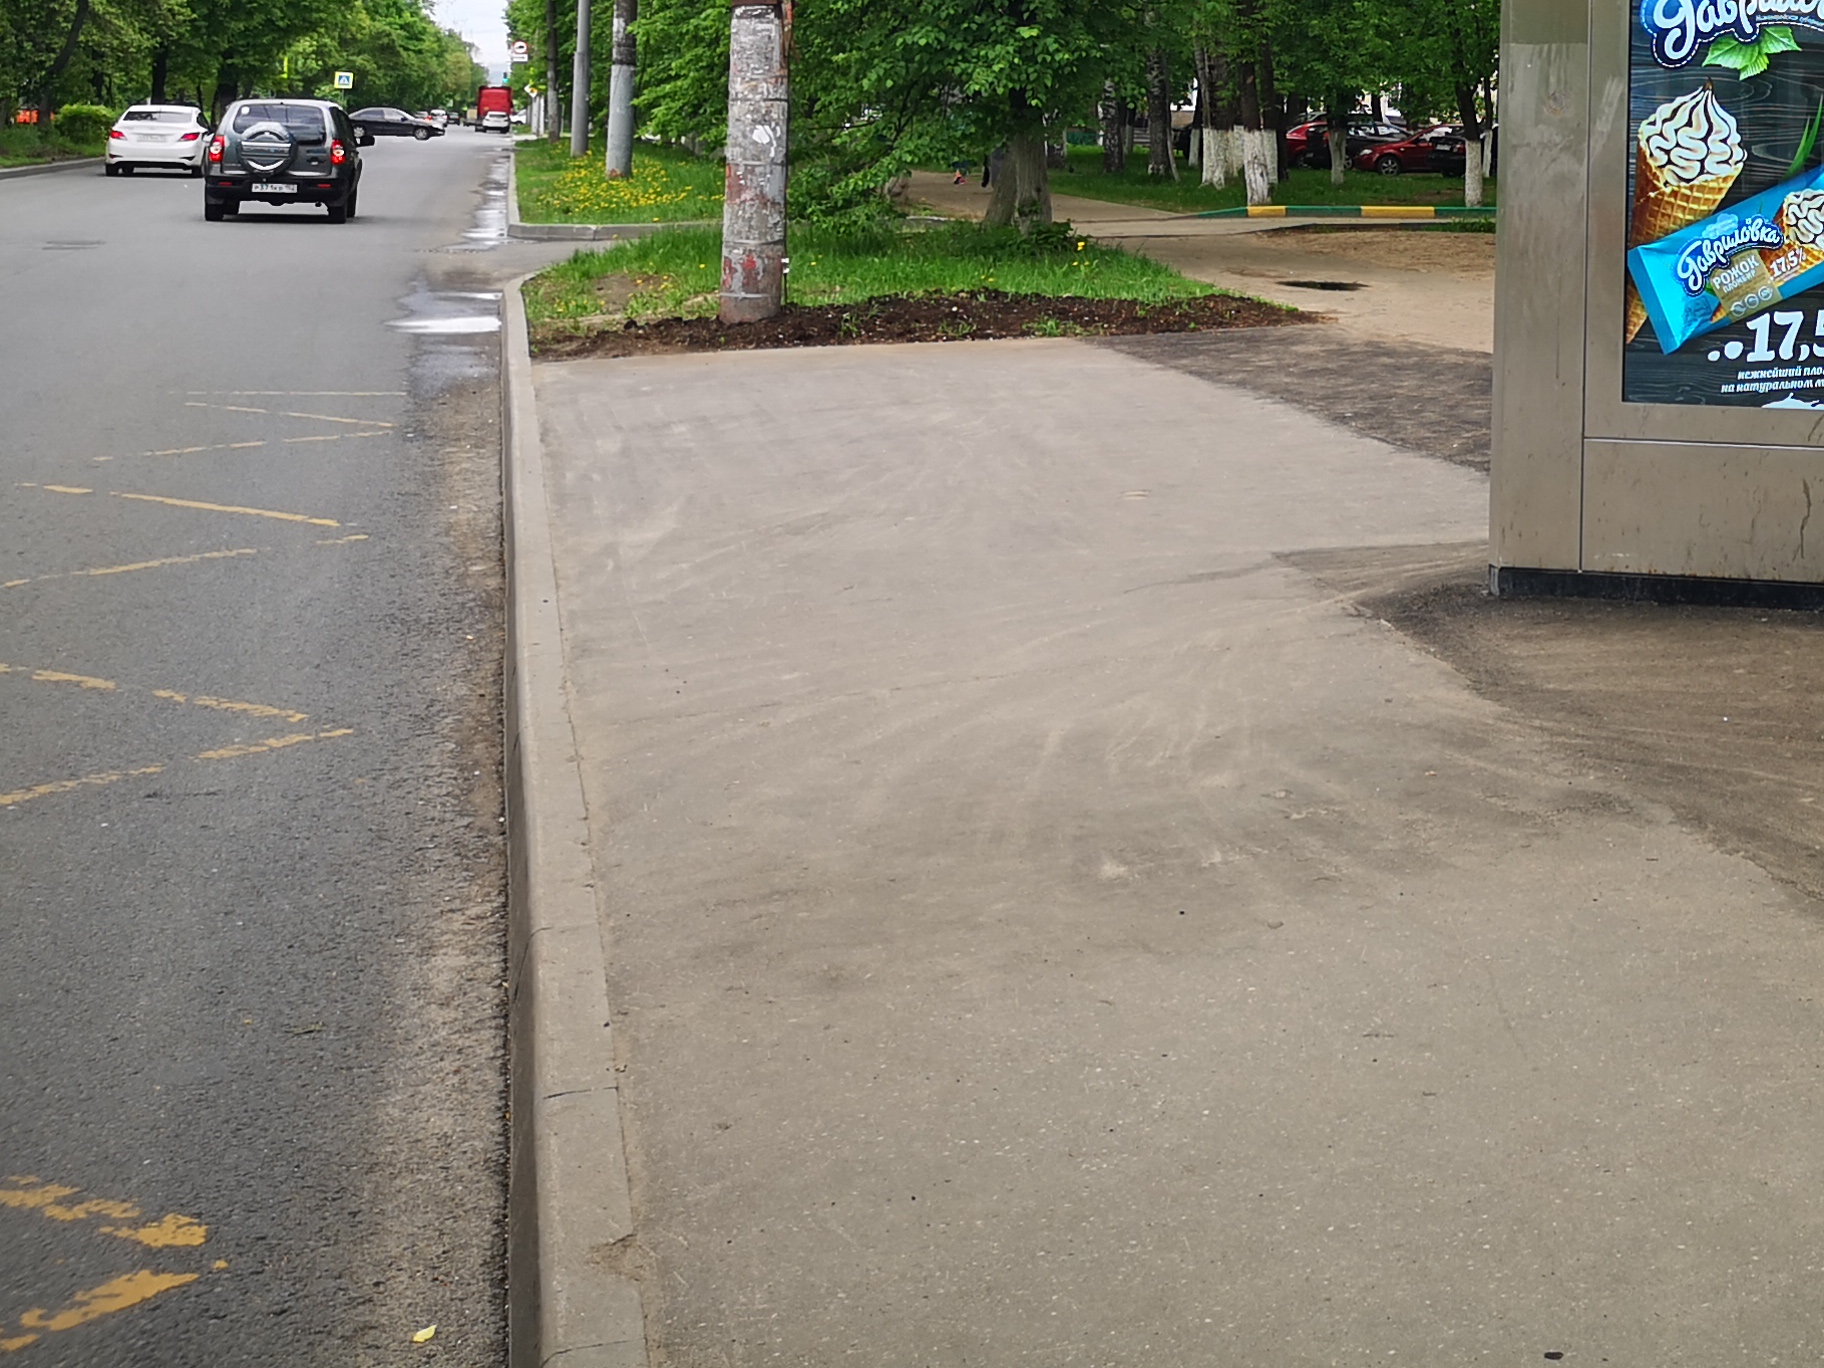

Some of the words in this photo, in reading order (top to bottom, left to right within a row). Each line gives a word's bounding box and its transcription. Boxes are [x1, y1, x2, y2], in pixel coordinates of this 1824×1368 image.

[1678, 217, 1780, 292] Гавриловка
[1770, 247, 1807, 277] 17,5%
[1712, 254, 1760, 289] РОЖОК
[1722, 268, 1757, 294] ПЛОМБИР
[1721, 383, 1735, 393] на
[1736, 379, 1814, 394] натуральном
[1737, 366, 1802, 380] нежнейший
